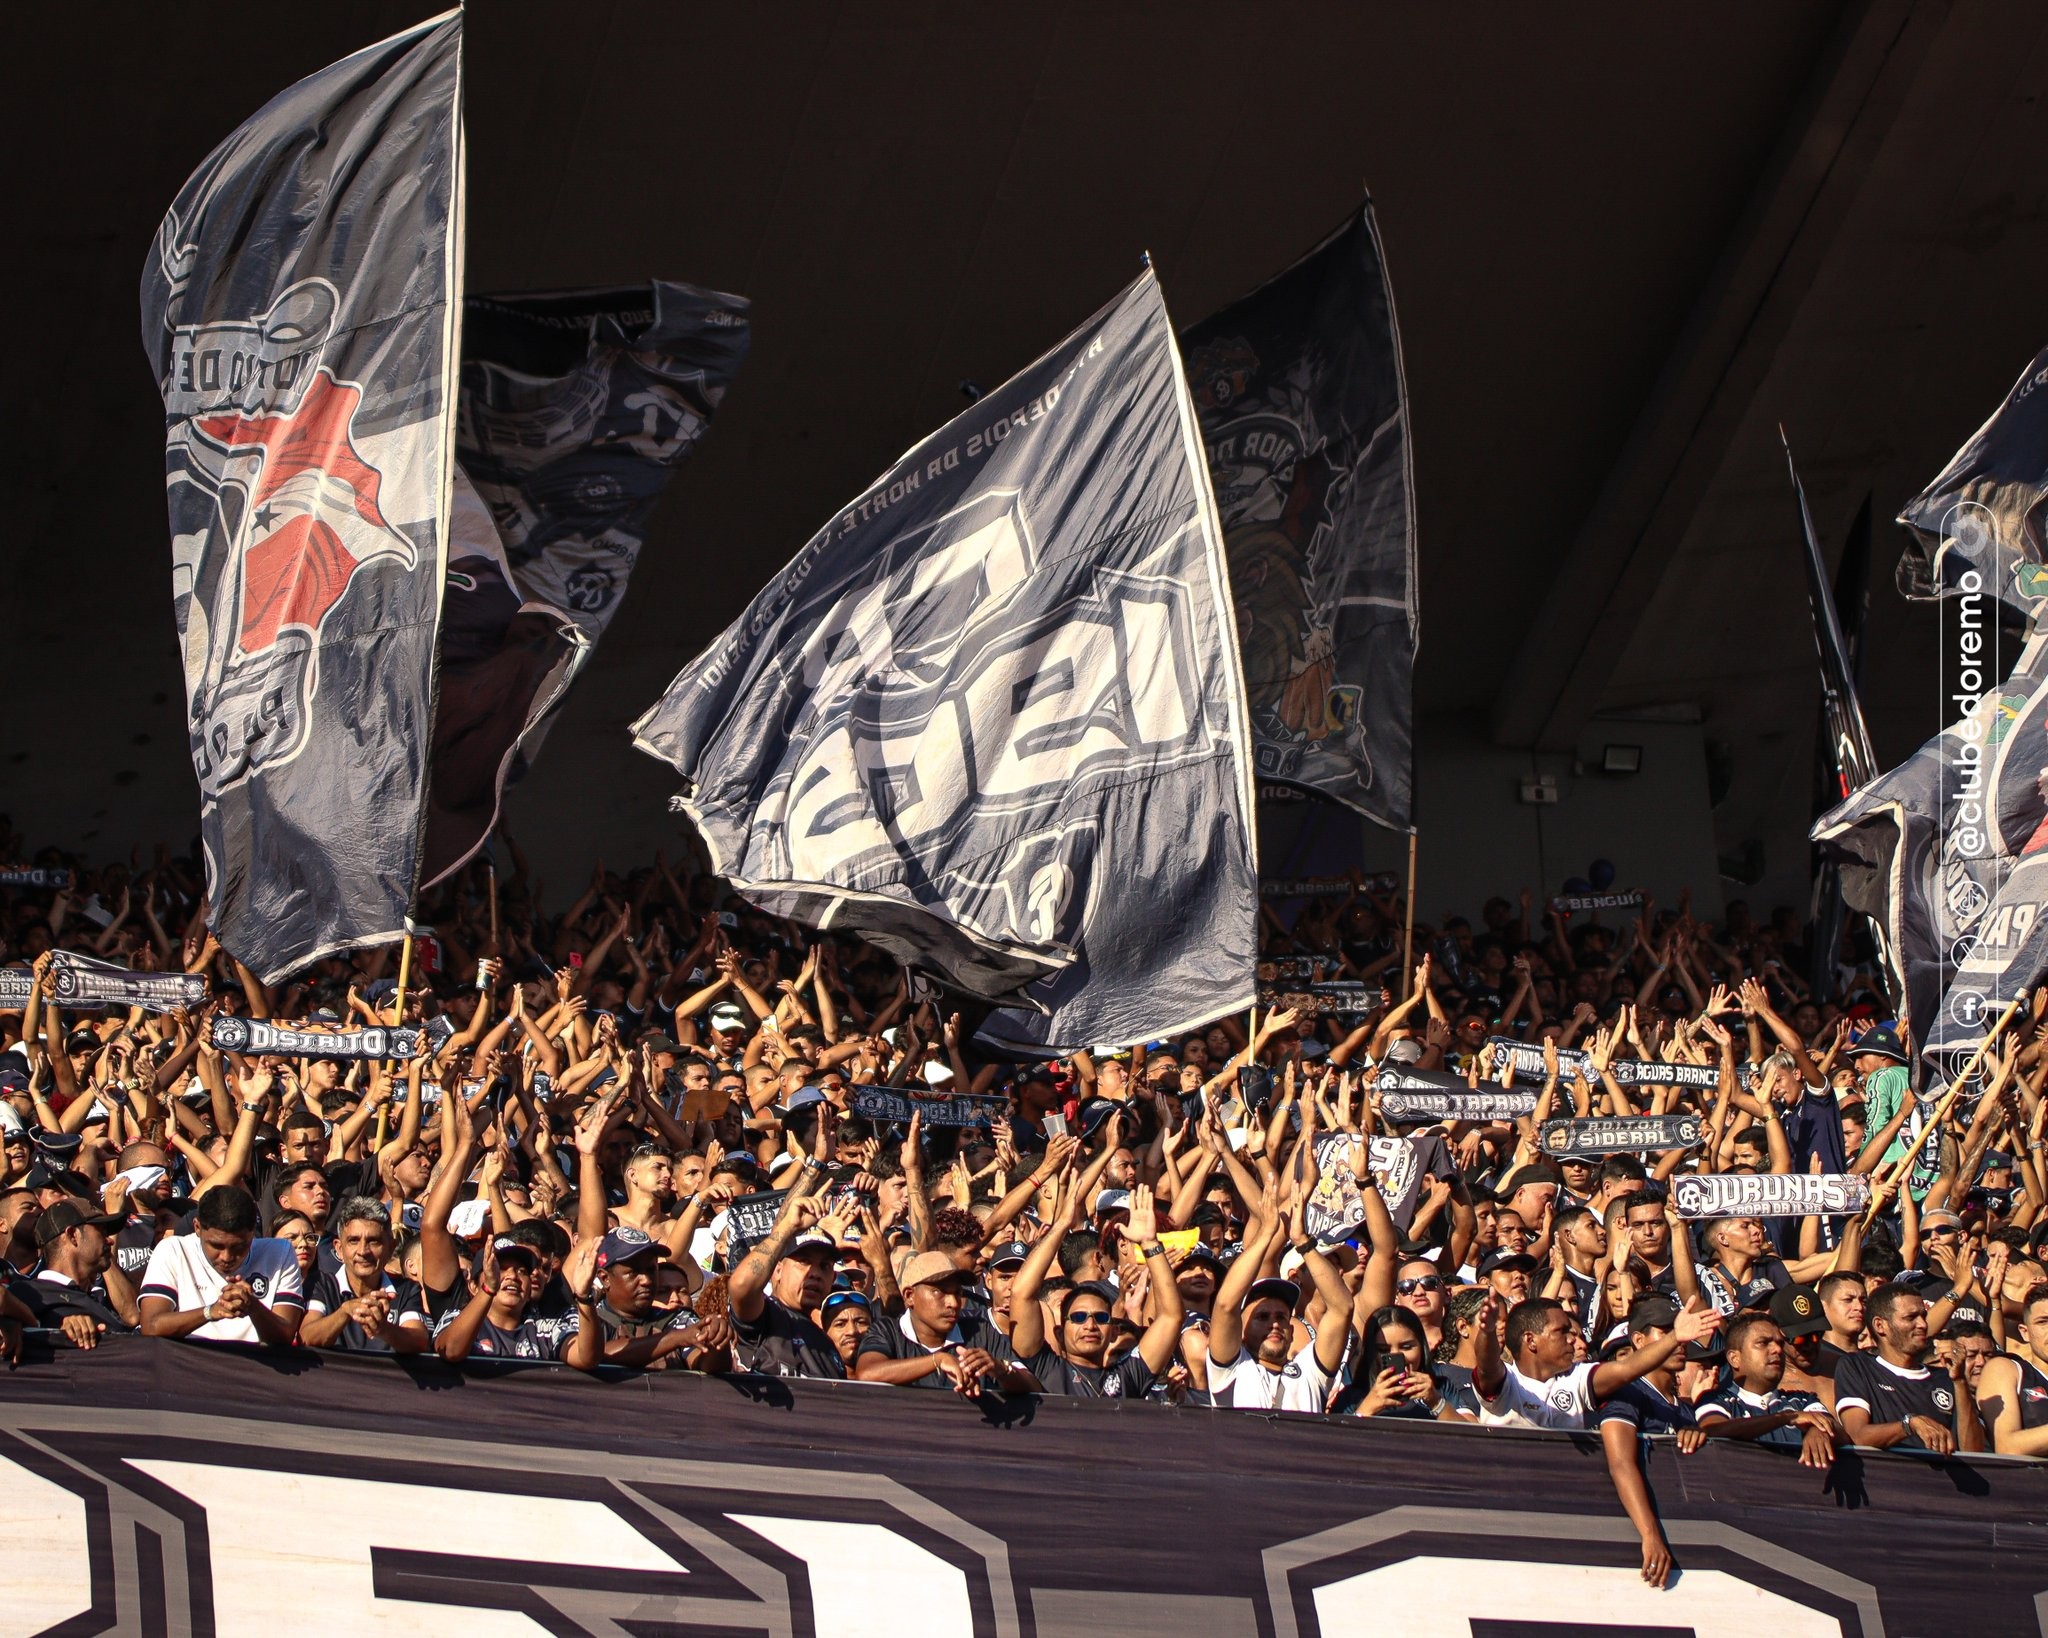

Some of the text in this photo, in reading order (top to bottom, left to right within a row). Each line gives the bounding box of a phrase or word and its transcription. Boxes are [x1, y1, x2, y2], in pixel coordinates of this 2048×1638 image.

[251, 1024, 384, 1056] DISTRITO
[1635, 1062, 1674, 1082] ÁGUAS
[1578, 1131, 1671, 1148] SIDERAL
[1701, 1175, 1847, 1214] JURUNAS
[1729, 1203, 1770, 1215] TROPA
